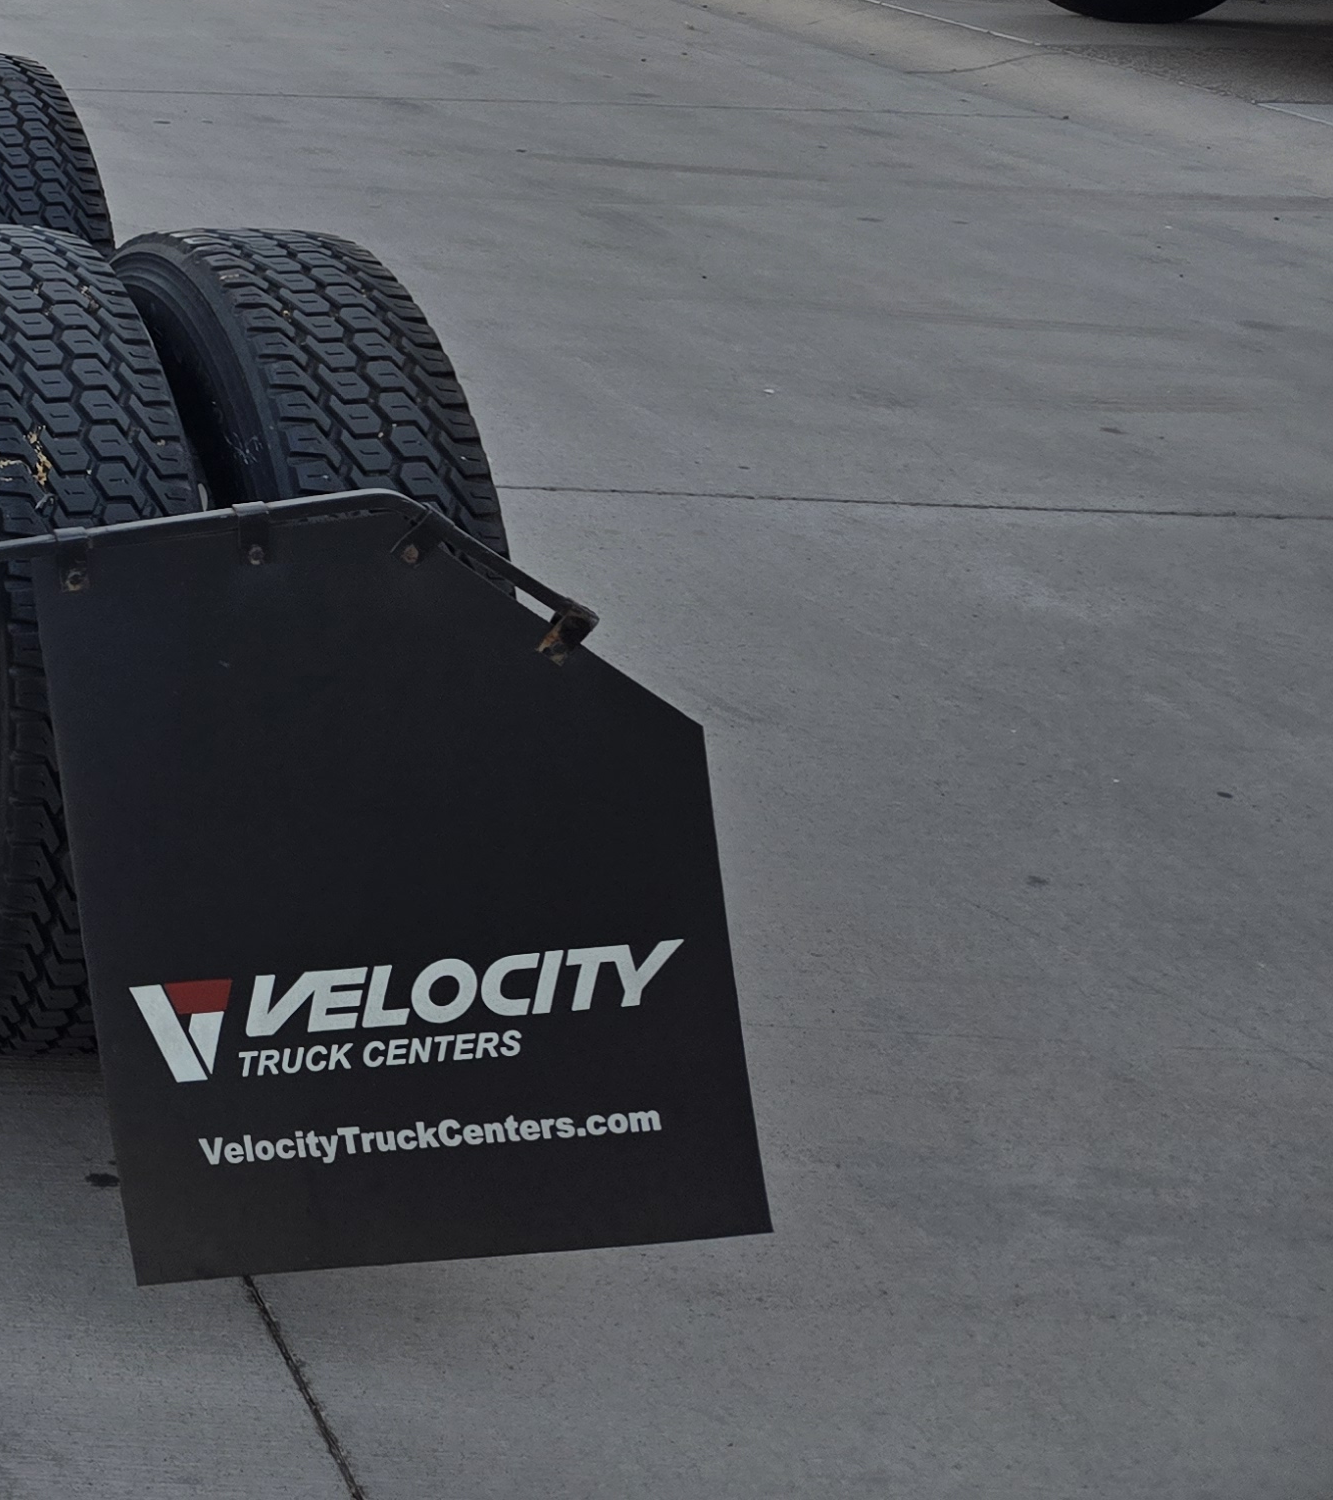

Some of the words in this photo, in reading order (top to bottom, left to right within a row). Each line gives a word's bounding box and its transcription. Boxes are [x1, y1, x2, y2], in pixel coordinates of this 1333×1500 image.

[245, 938, 685, 1038] VELOCITY
[238, 1043, 353, 1077] TRUCK
[362, 1029, 522, 1068] CENTERS
[199, 1109, 662, 1165] VelocityTruckCenters.com
